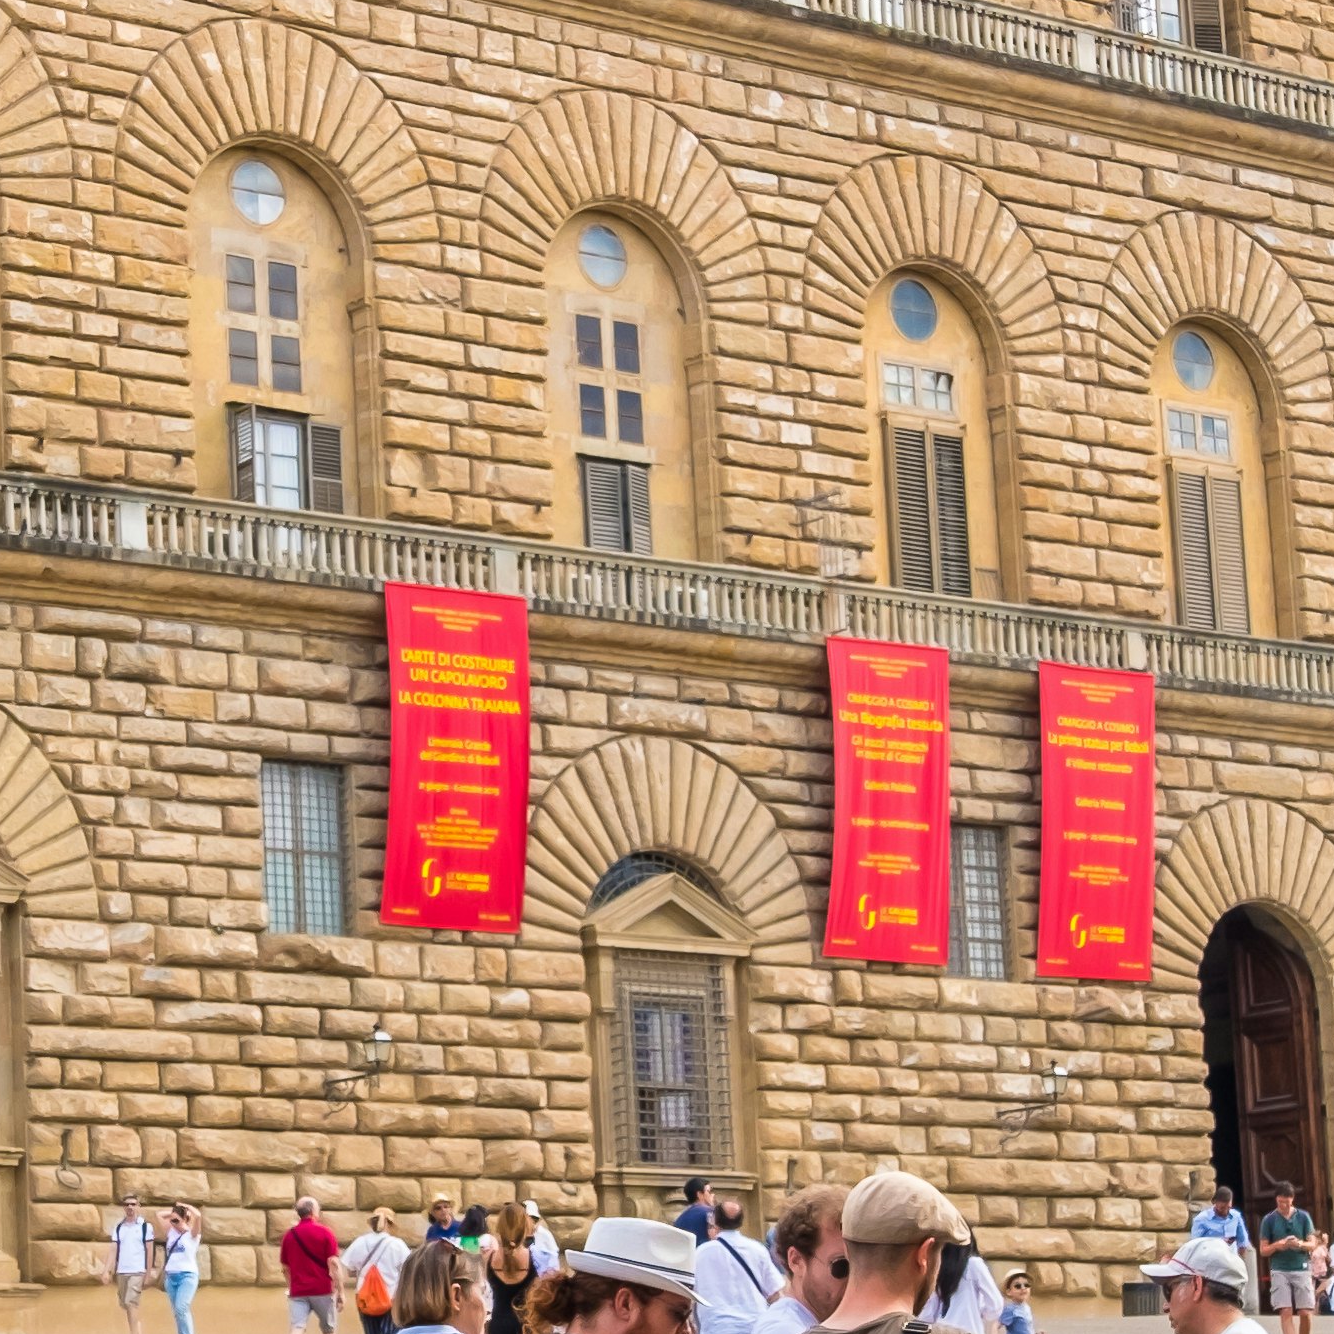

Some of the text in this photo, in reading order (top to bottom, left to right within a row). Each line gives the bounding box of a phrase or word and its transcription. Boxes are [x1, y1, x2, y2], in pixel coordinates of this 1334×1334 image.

[438, 653, 450, 666] DI
[453, 654, 515, 673] COSTRUIRE
[410, 668, 507, 690] UN CAPOLAVORO
[399, 691, 412, 704] LA
[414, 692, 469, 709] COLONNA
